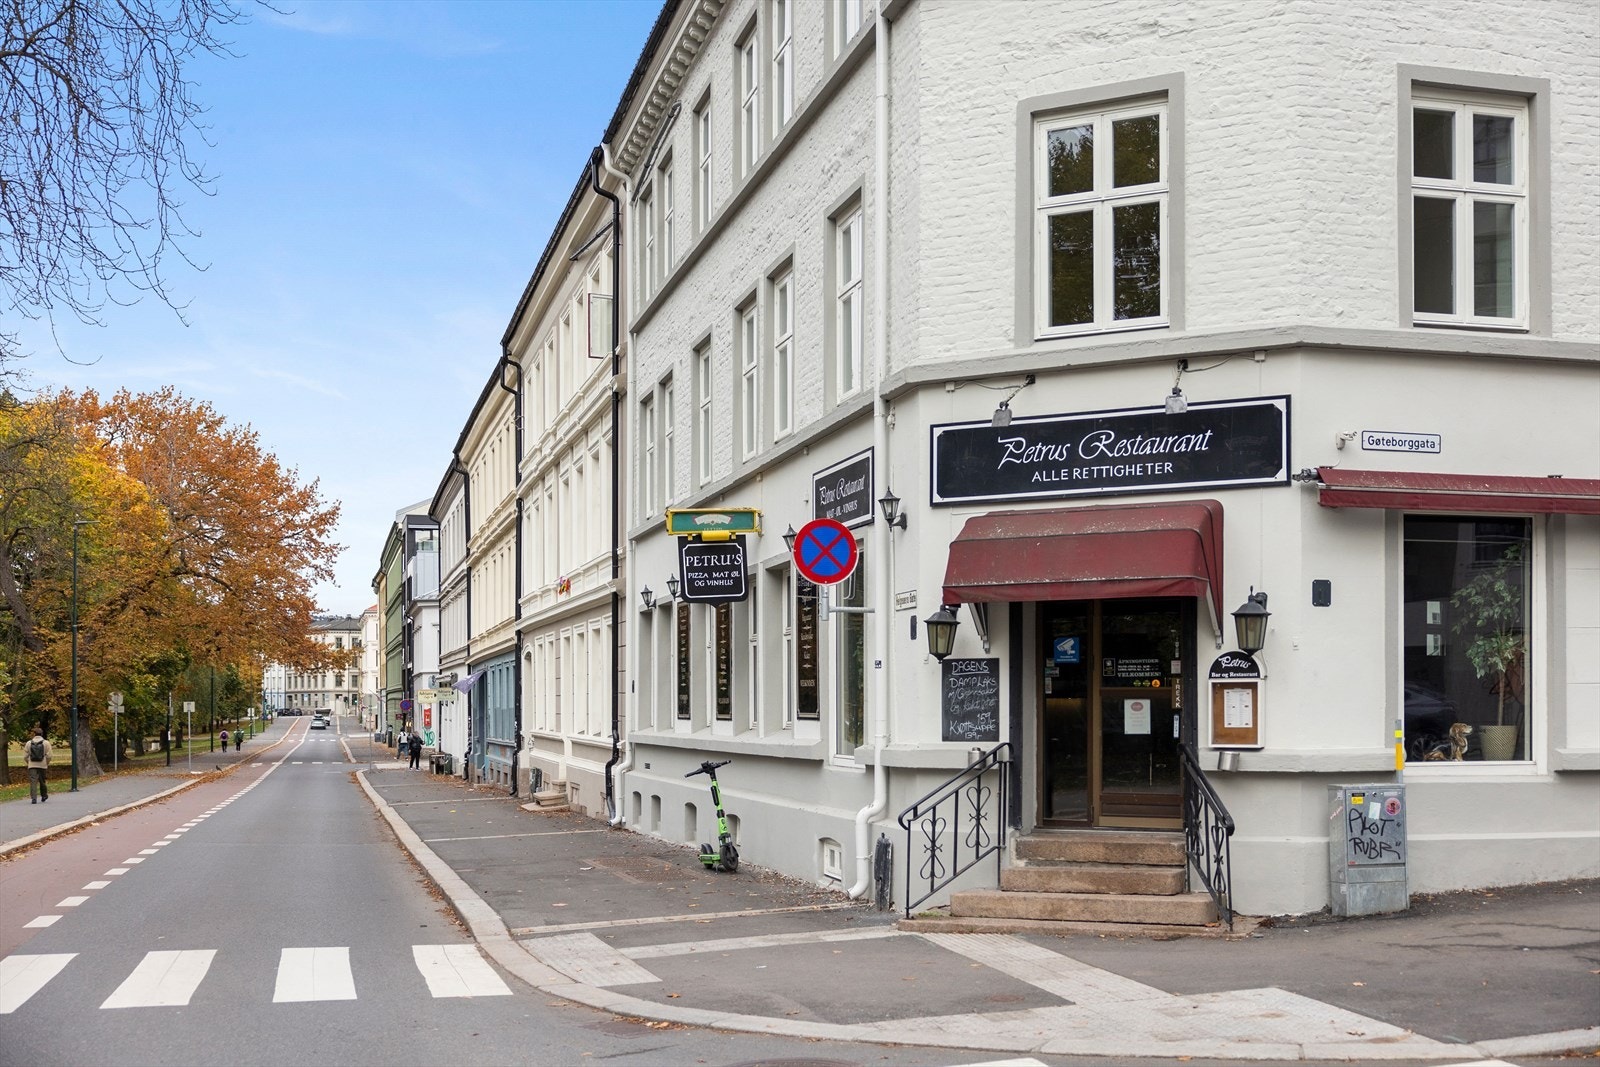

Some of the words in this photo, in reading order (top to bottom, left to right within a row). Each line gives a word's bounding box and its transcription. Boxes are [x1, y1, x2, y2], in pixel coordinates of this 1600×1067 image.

[997, 436, 1070, 469] Petrus
[1078, 429, 1213, 460] Restaurant
[1367, 435, 1436, 450] Gøteborggata
[1031, 469, 1068, 482] ALLE
[1073, 462, 1173, 480] RETTIGHETER
[685, 553, 743, 567] PETRU'S
[951, 660, 989, 673] DAGENS
[1218, 655, 1251, 668] Petrus
